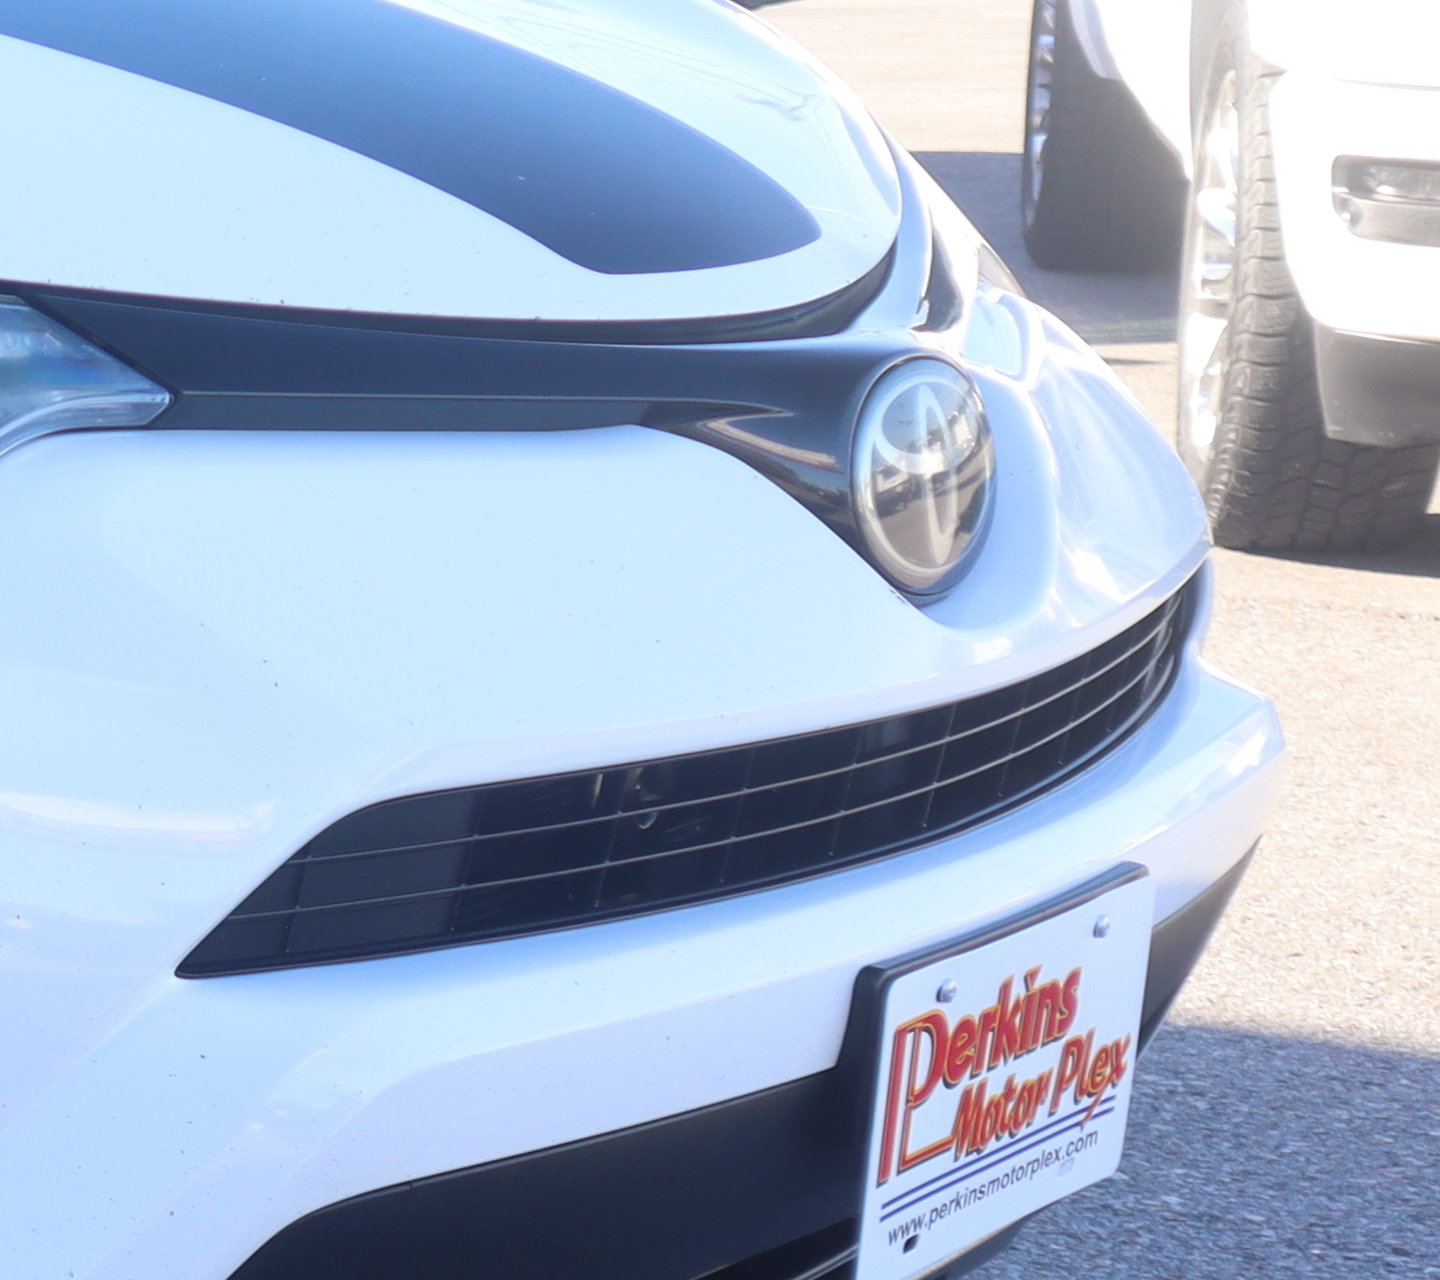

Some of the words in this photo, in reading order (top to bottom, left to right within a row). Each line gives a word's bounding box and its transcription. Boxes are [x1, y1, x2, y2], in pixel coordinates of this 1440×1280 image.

[876, 964, 1083, 1189] Perkins
[955, 1067, 1054, 1161] Motor
[1049, 1027, 1131, 1132] Plex
[886, 1128, 1099, 1245] www.perkinsmotorplex.com
